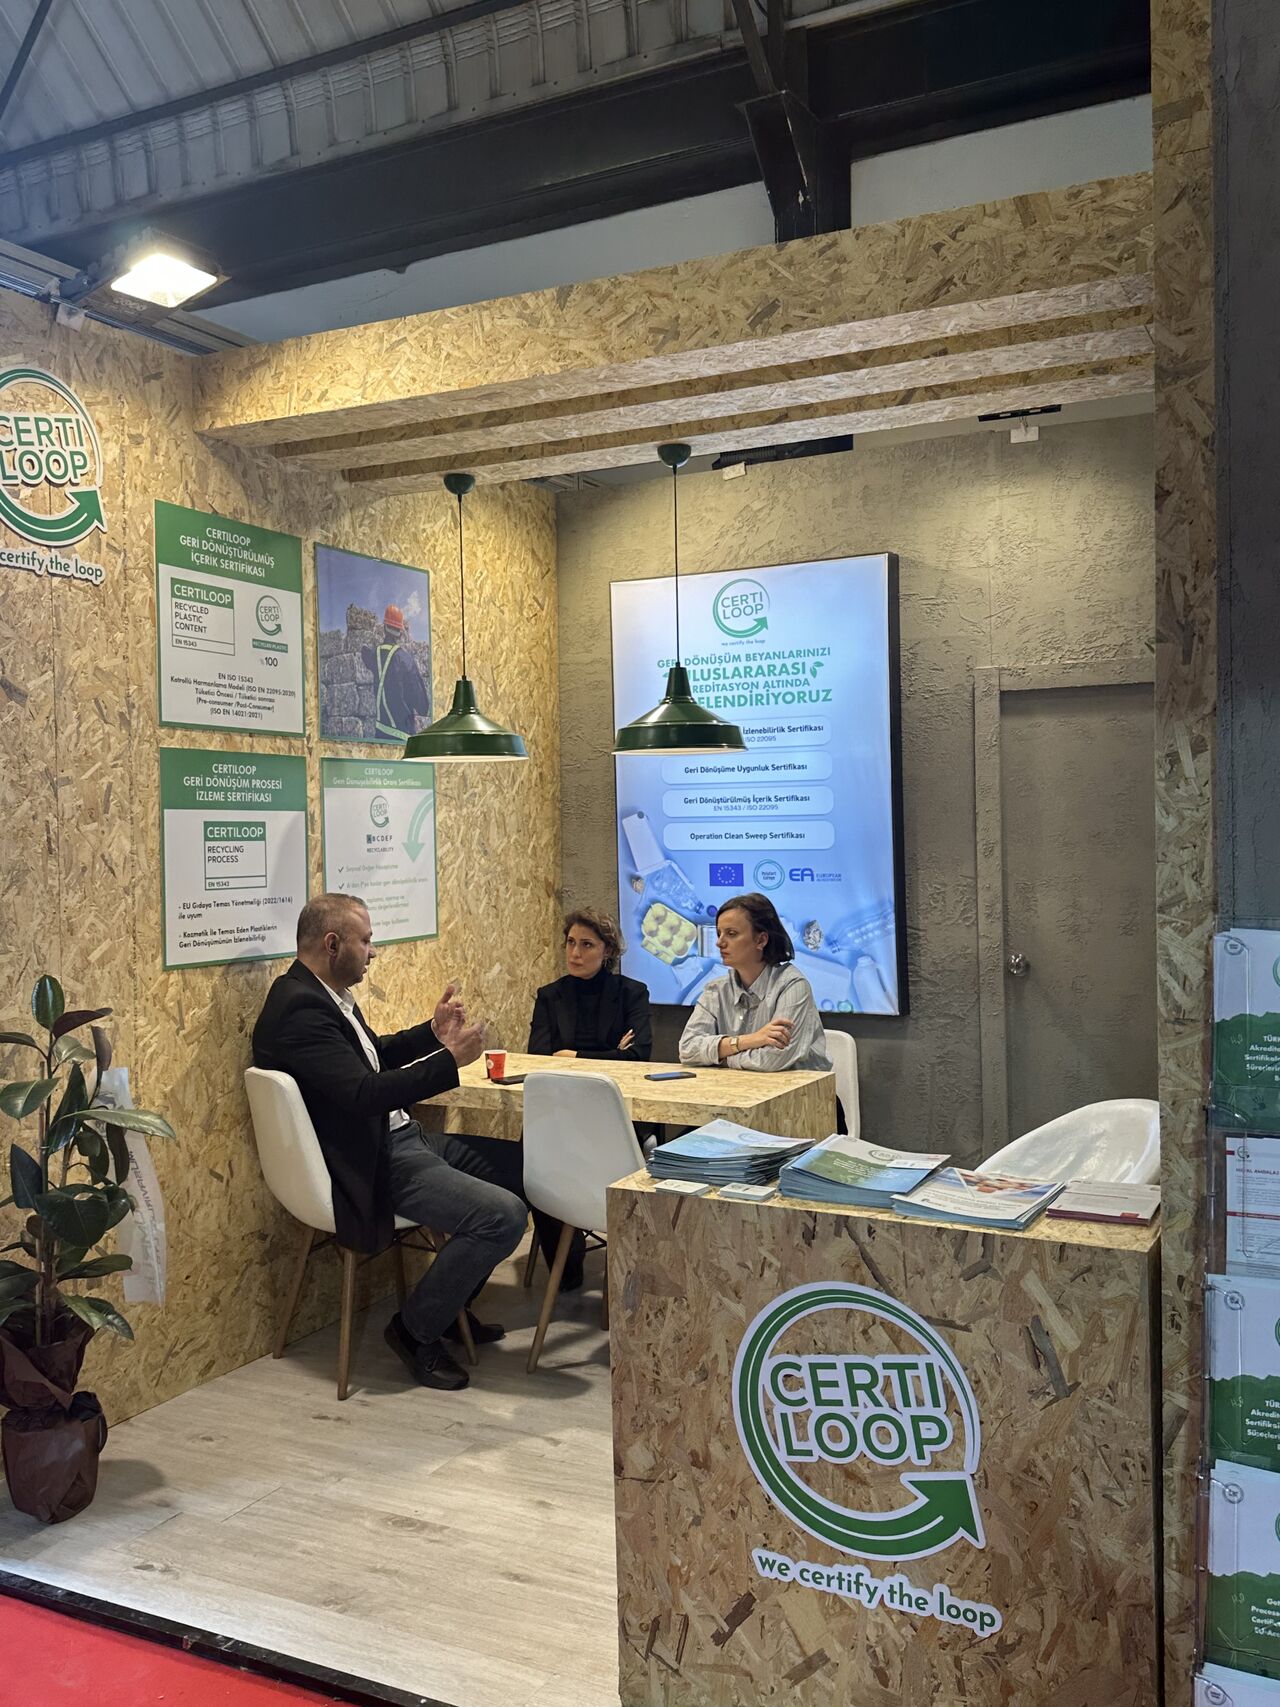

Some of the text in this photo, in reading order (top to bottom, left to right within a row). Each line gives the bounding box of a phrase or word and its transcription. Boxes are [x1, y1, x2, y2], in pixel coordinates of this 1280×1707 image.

[0, 415, 84, 447] CERTI
[0, 450, 88, 481] LOOP
[206, 527, 251, 546] CERTILOOP
[180, 535, 275, 569] GERİ DÖNÜŞTÜRÜLMÜŞ
[0, 551, 103, 581] certify the loop
[191, 549, 265, 578] İÇERİK SERTİFİKASI
[174, 584, 232, 605] CERTILOOP
[721, 591, 763, 609] CERTI
[174, 602, 209, 615] RECYCLED
[259, 605, 280, 614] CERTI
[723, 603, 764, 620] LOOP
[174, 611, 203, 623] PLASTIC
[260, 614, 280, 622] LOOP
[174, 621, 207, 633] CONTENT
[657, 646, 831, 668] GER DÖNÜŞÜM BEYANLARINIZI
[692, 677, 810, 694] REDİTASYON ALTINDA
[787, 725, 824, 733] Sertifikası
[212, 763, 257, 775] CERTILOOP
[700, 765, 736, 774] Dönüşüme
[737, 764, 770, 775] Uygunluk
[771, 763, 808, 771] Sertifikası
[183, 774, 282, 790] GERİ DÖNÜŞÜM PROSESİ
[196, 788, 272, 802] İZLEME SERTİFİKASI
[684, 794, 810, 806] Geri Dönüştürülmüş İçerik Sertifikası
[207, 827, 264, 838] CERTILOOP
[690, 832, 805, 841] Operation Clean Sweep Sertifikası
[207, 845, 244, 854] RECYCLING
[207, 855, 239, 863] PROCESS
[789, 868, 815, 882] EA
[769, 1361, 941, 1409] CERTI
[781, 1414, 949, 1461] LOOP
[758, 1557, 997, 1633] we certify the loop
